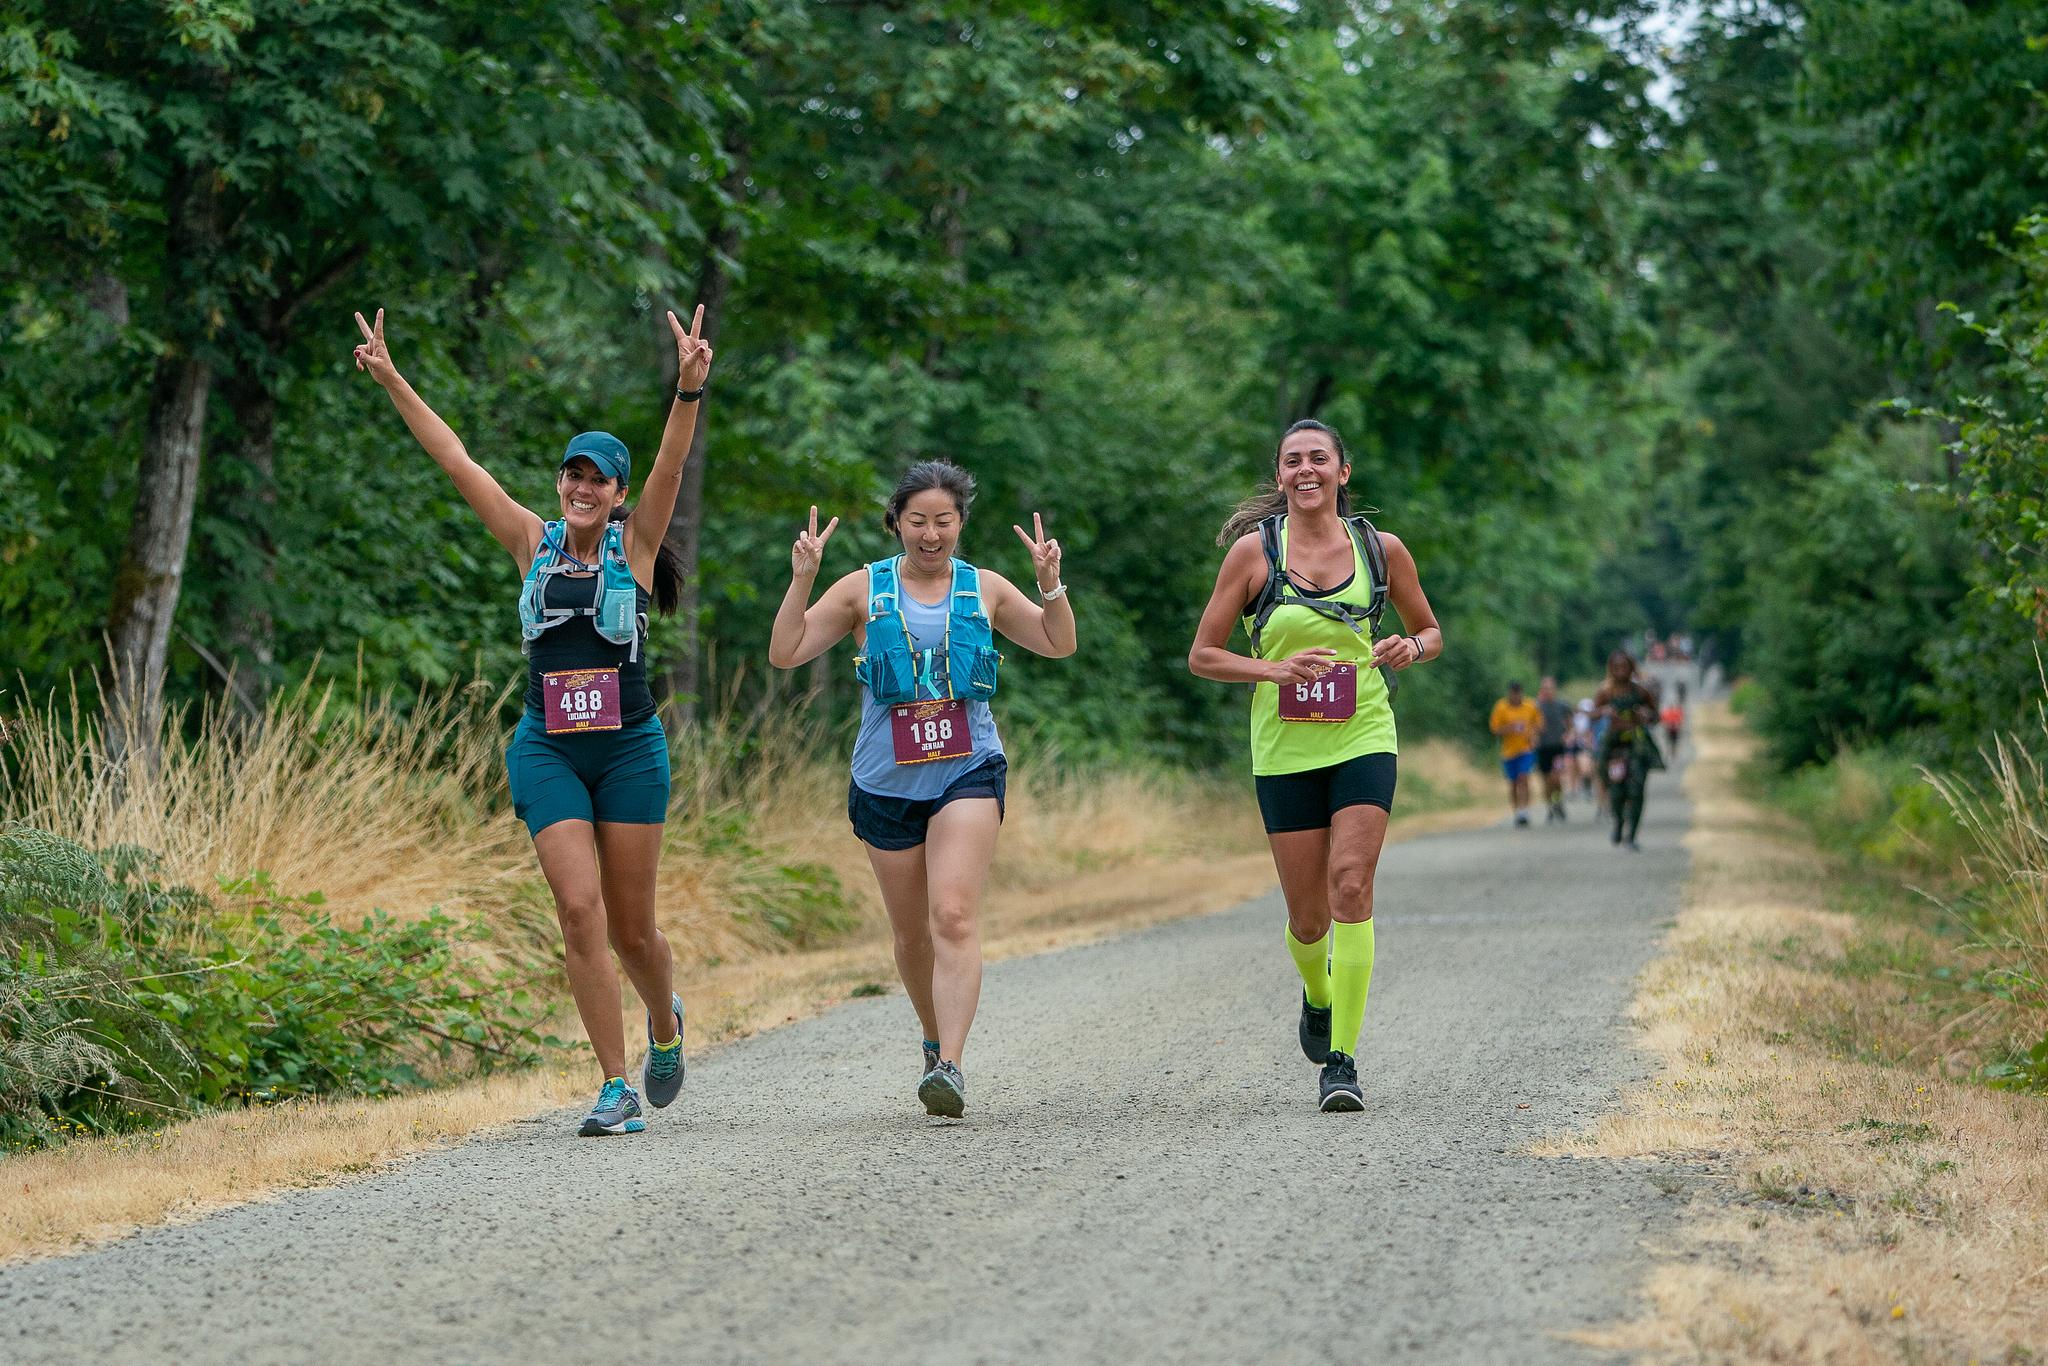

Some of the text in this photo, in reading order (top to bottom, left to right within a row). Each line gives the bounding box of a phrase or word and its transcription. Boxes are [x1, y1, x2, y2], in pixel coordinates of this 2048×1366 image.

[560, 690, 603, 713] 488
[1296, 681, 1335, 702] 541
[910, 719, 953, 744] 188
[921, 742, 932, 751] JEN
[927, 750, 941, 758] HALF
